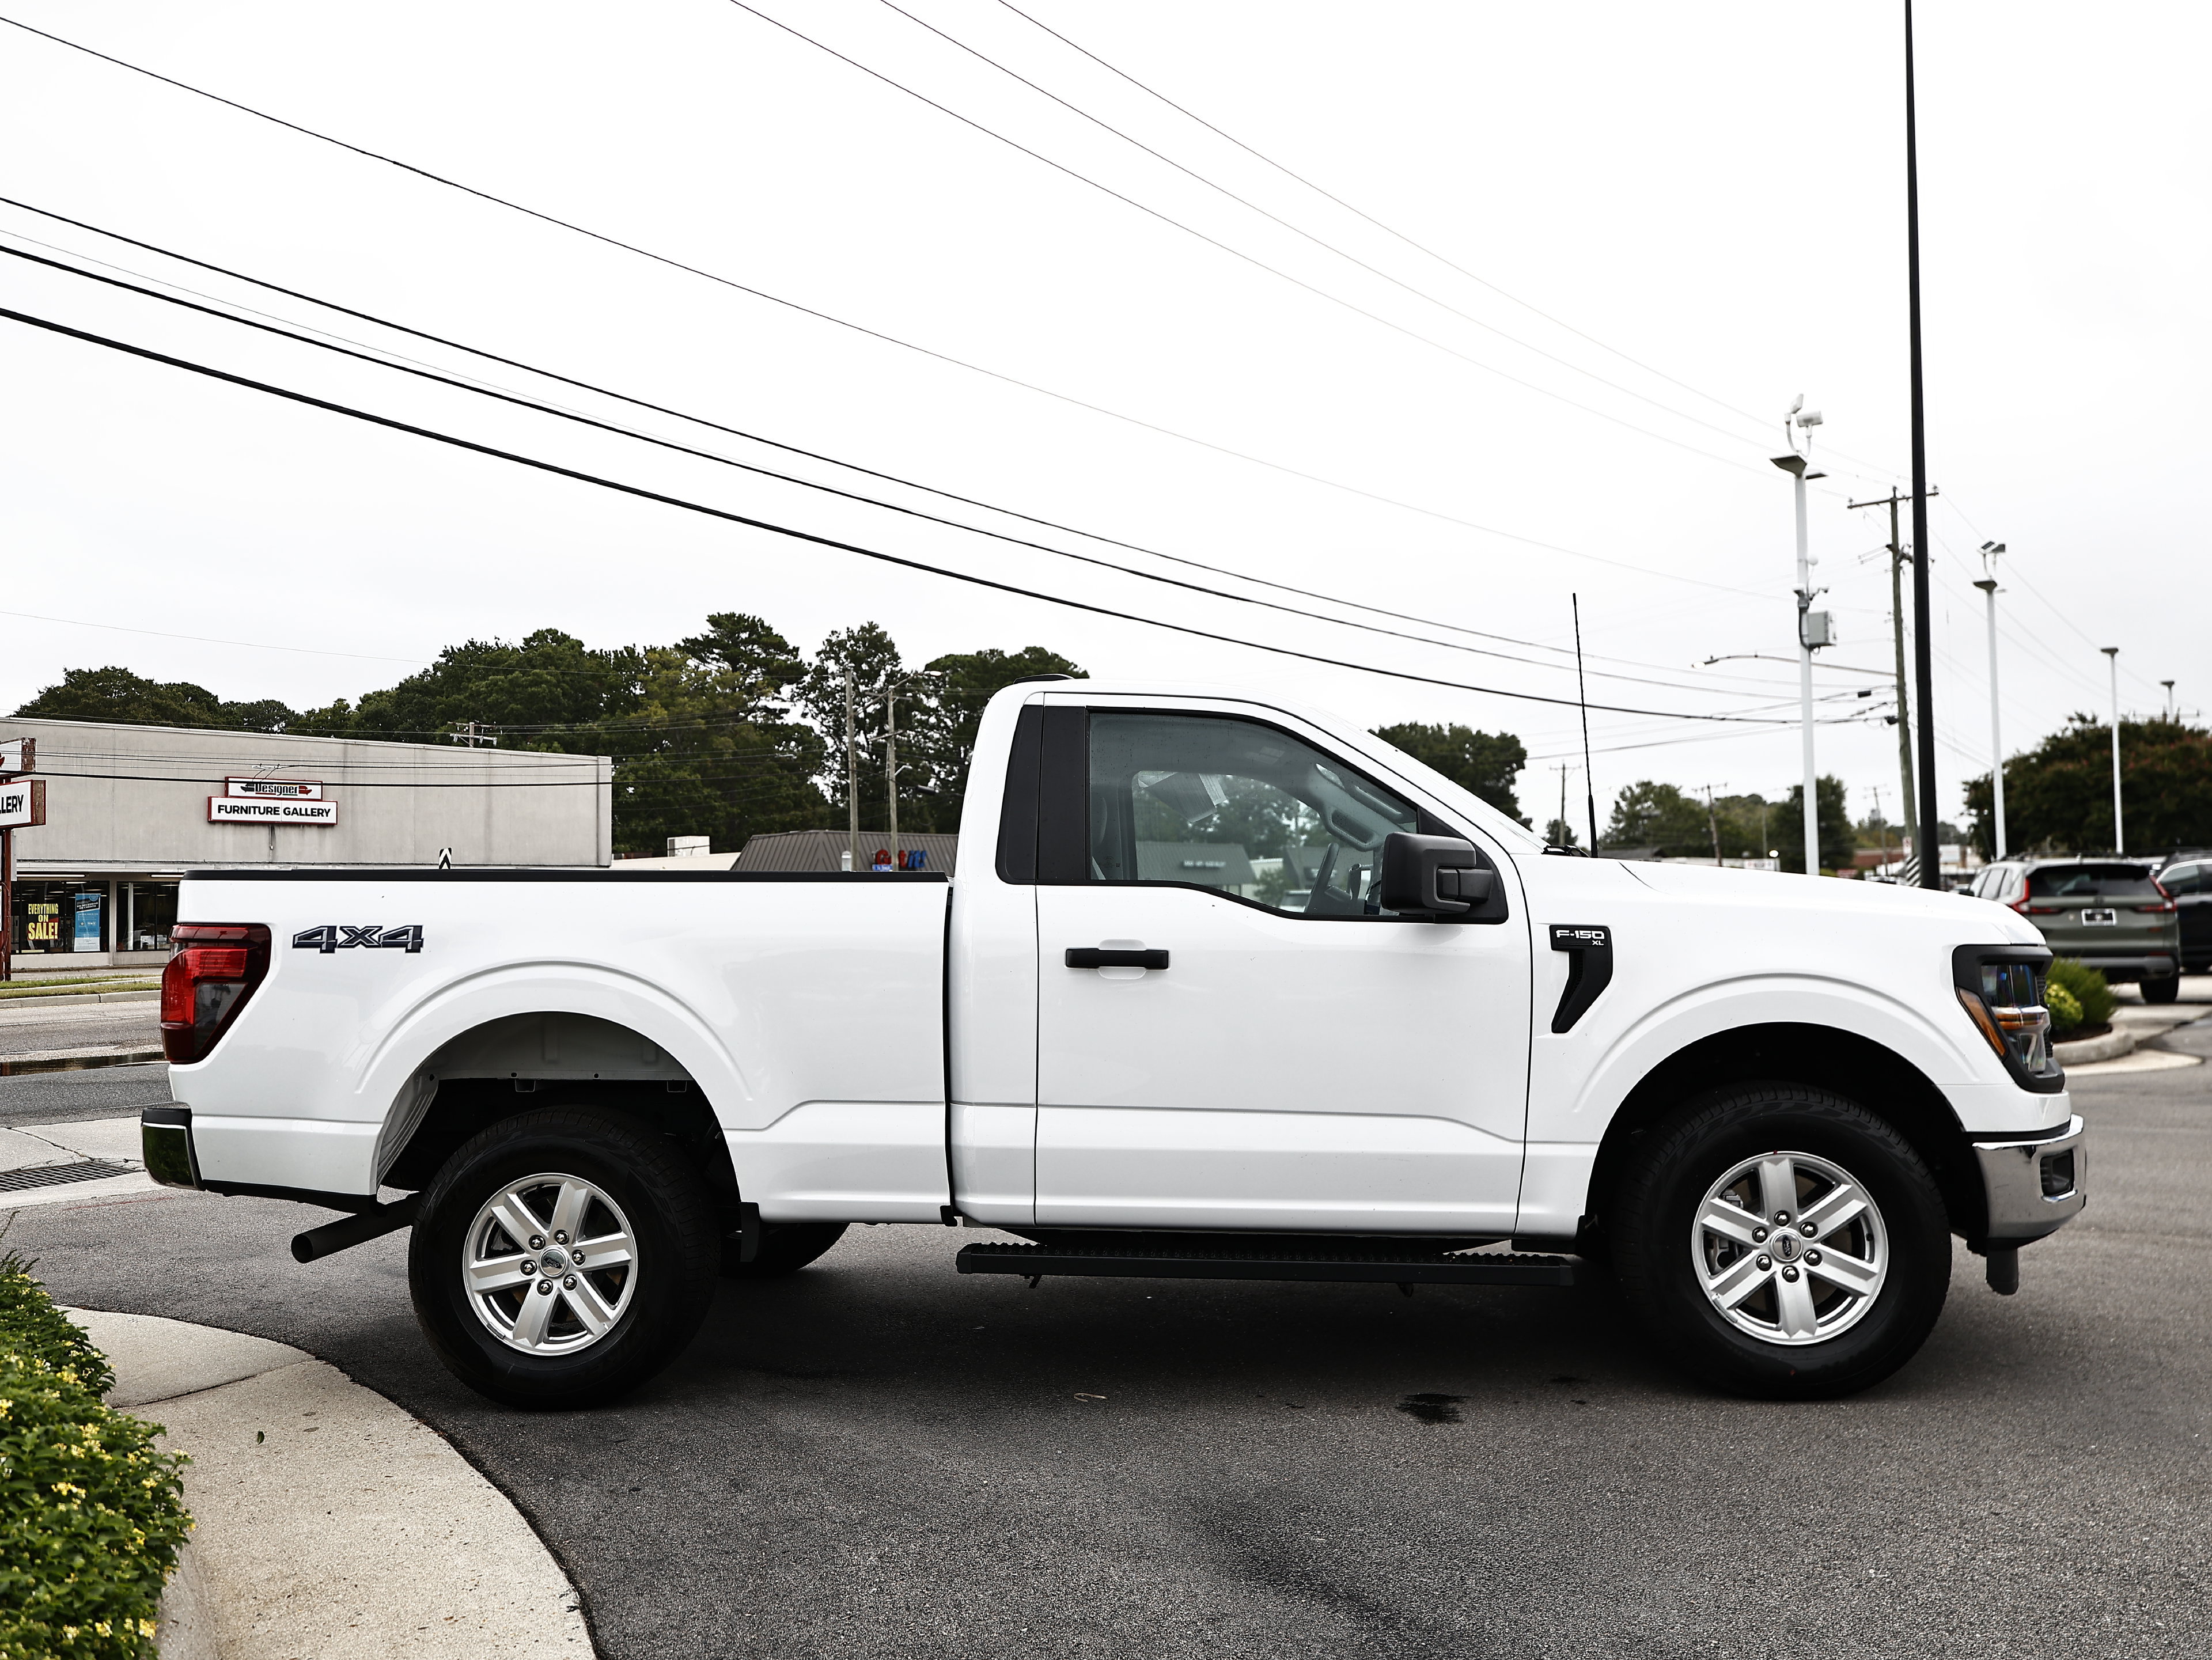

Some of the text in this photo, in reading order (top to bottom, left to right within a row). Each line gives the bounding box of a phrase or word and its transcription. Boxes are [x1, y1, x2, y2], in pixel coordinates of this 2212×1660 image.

[254, 783, 298, 795] Designer
[0, 794, 24, 814] LERY
[218, 805, 331, 817] FURNITURE GALLERY
[875, 848, 907, 868] Gt
[28, 903, 59, 915] EVERYTHING
[28, 922, 58, 939] SALE!
[1556, 930, 1605, 939] F-150
